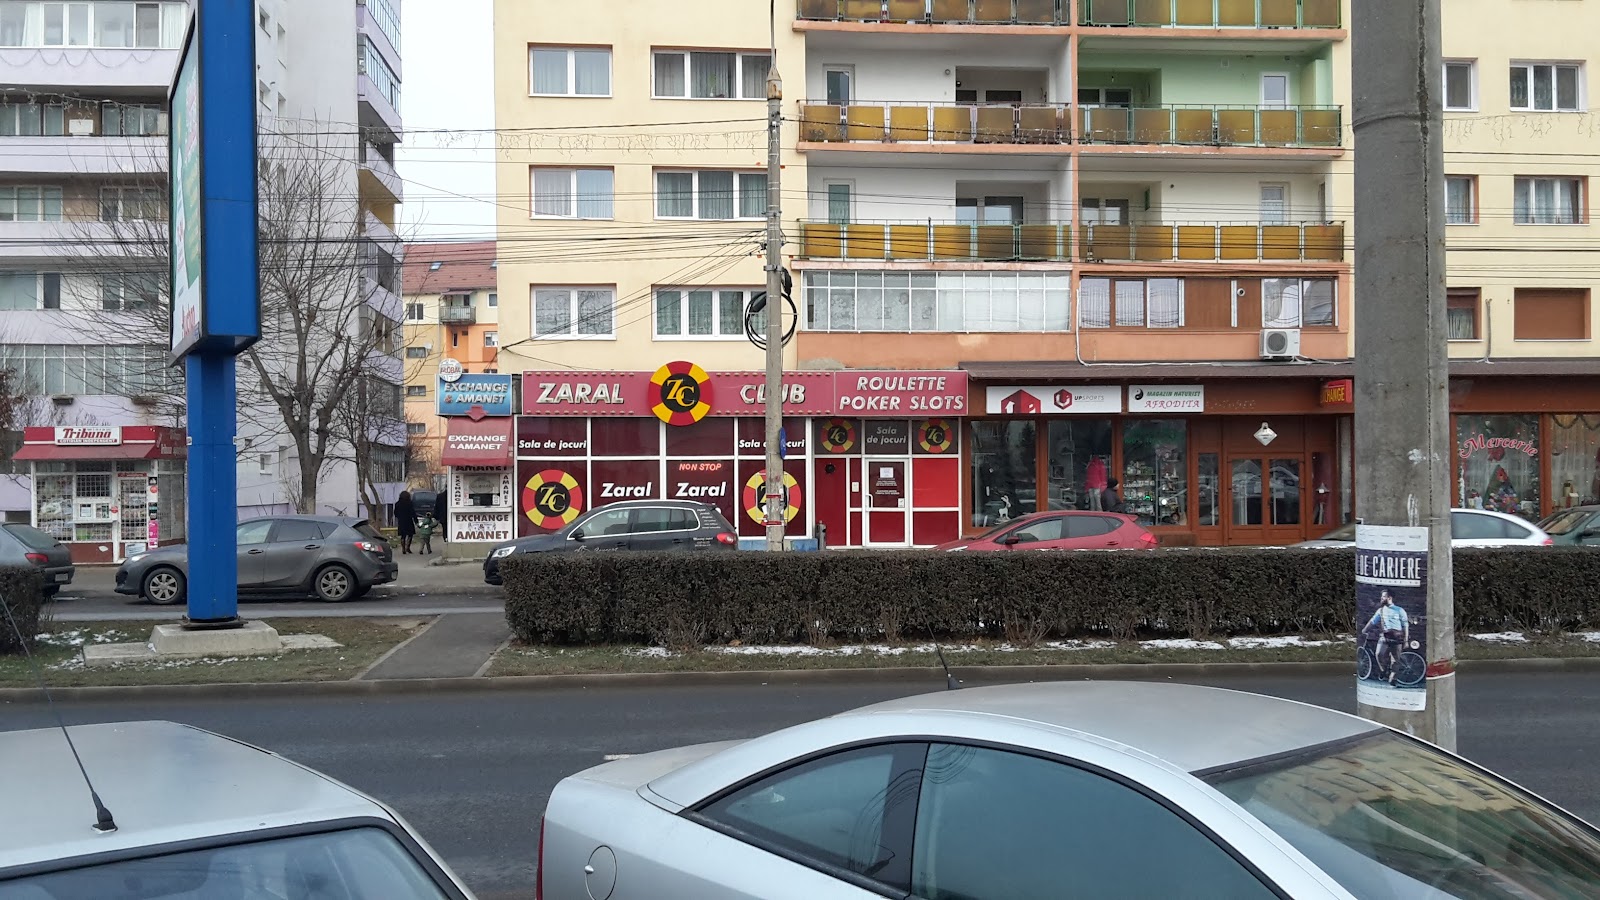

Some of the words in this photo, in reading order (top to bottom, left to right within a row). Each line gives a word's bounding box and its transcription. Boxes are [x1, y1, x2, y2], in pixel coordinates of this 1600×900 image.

[444, 382, 508, 393] EXCHANGE
[857, 376, 947, 391] ROULETTE
[444, 395, 453, 404] &
[456, 394, 505, 404] AMANET
[536, 383, 625, 404] ZARAL
[839, 396, 901, 410] POKER
[909, 396, 964, 410] SLOTS
[1144, 400, 1200, 409] AFRODITA
[62, 428, 111, 439] Tribuna
[876, 427, 897, 435] Sala
[518, 440, 541, 449] Sala
[544, 440, 556, 449] de
[558, 440, 587, 450] jocuri
[739, 439, 760, 448] Sala
[866, 436, 879, 444] de
[880, 436, 907, 445] jocuri
[1459, 434, 1538, 459] Mercerie
[679, 463, 697, 471] NON
[699, 463, 722, 471] STOP
[502, 475, 510, 505] AMANET
[600, 482, 652, 497] Zaral
[675, 482, 727, 497] Zaral
[456, 531, 509, 539] AMANET
[1373, 556, 1422, 579] CARIERE
